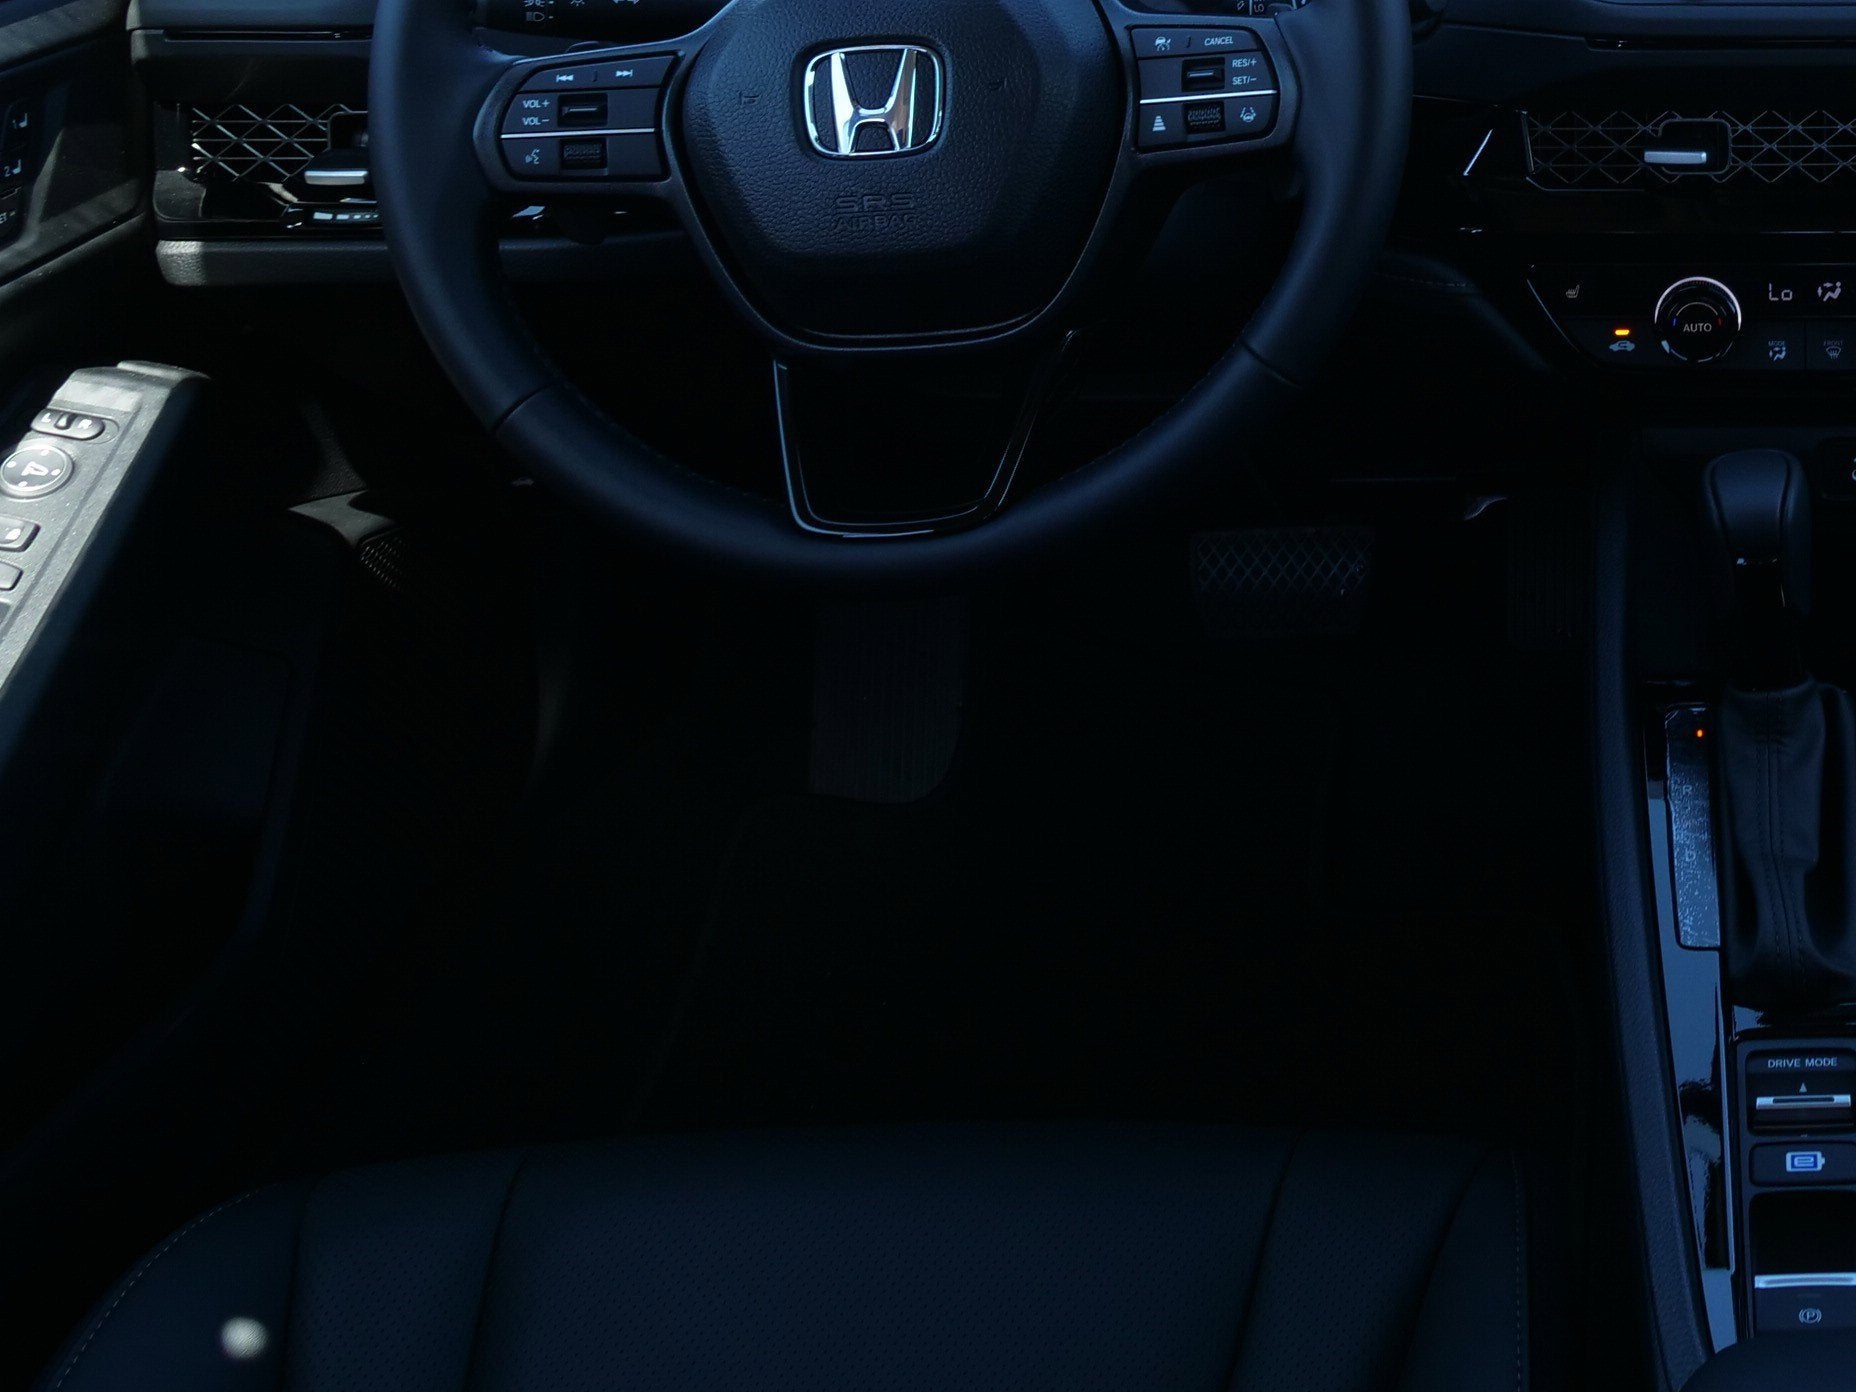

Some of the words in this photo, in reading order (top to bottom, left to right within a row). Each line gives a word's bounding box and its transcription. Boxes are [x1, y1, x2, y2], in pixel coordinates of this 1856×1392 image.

[1204, 36, 1234, 46] CANCEL
[1232, 58, 1258, 68] RES/+
[522, 99, 551, 108] VOL+
[835, 193, 915, 211] SRS
[1683, 322, 1712, 333] AUTO
[1767, 1058, 1800, 1068] DRIVE
[1805, 1056, 1838, 1067] MODE
